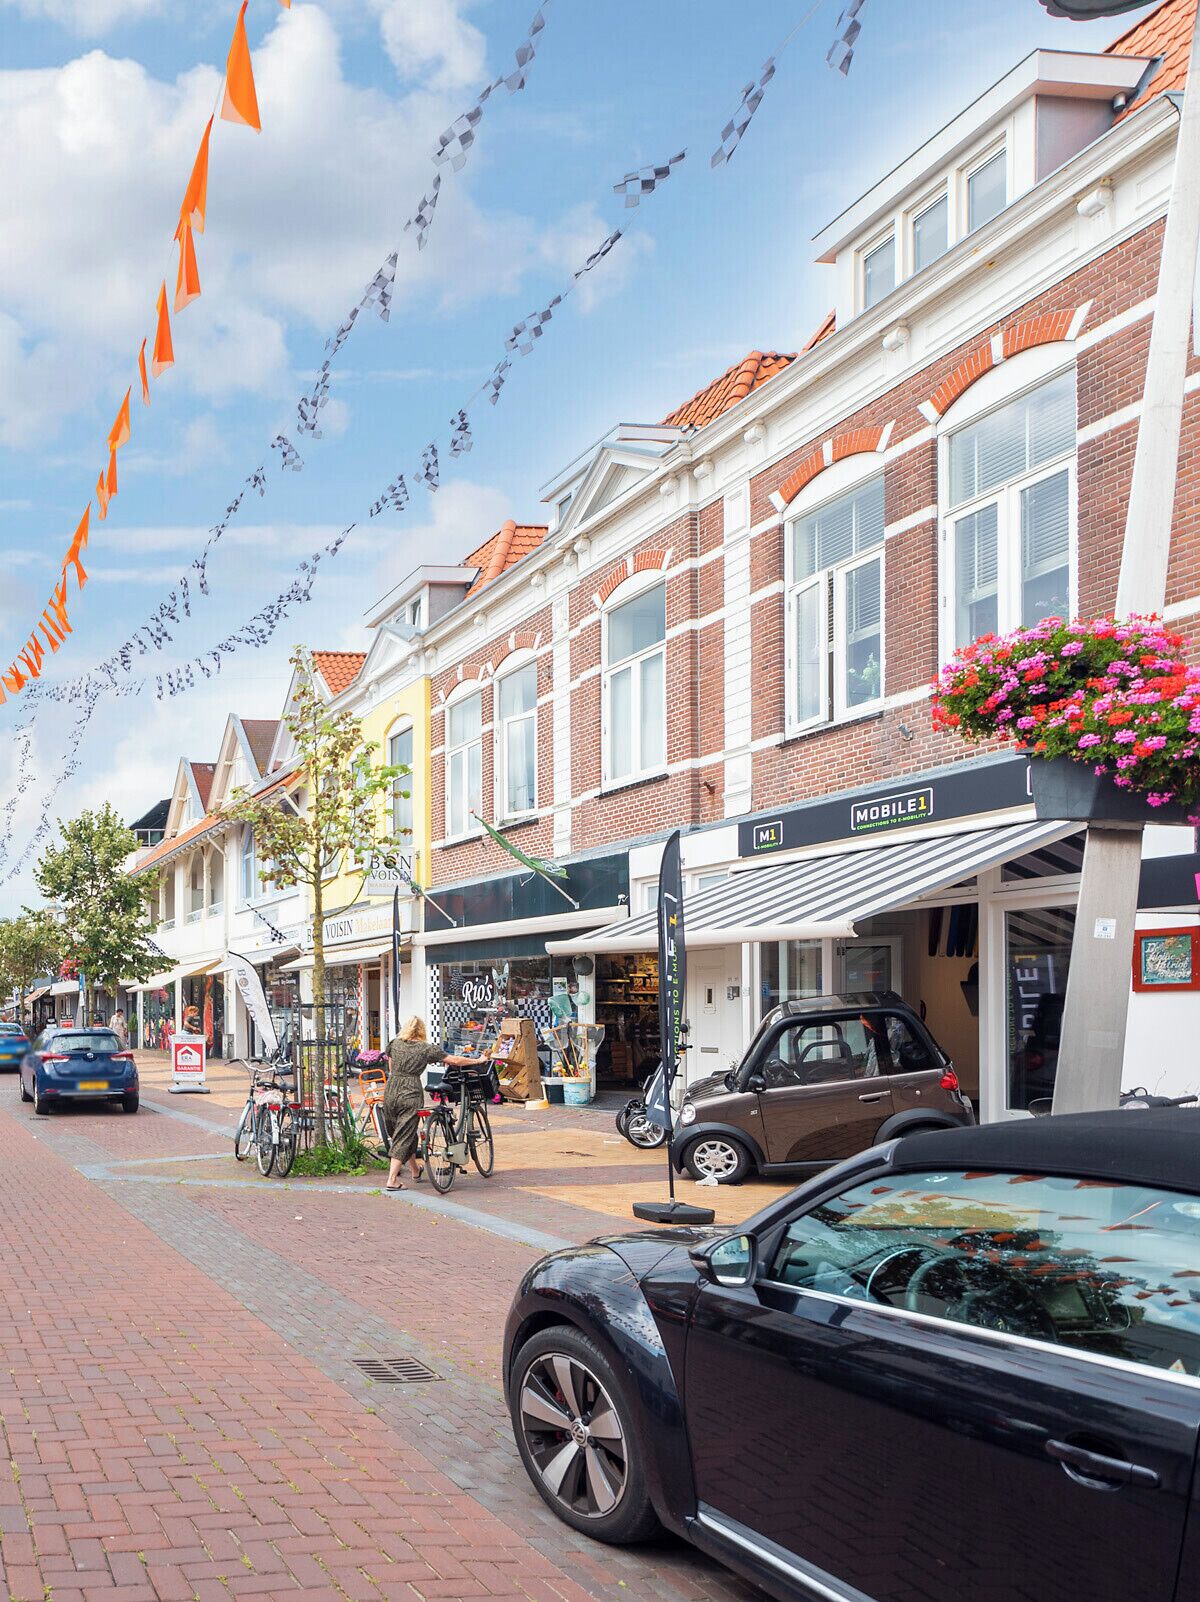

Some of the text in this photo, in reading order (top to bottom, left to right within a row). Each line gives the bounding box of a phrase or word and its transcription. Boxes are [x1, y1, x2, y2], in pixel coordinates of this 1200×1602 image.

[856, 796, 927, 823] MOBILE1
[856, 819, 889, 831] CONNECTIONS
[898, 813, 927, 822] E-MOBILITY
[760, 828, 777, 843] M1
[325, 919, 353, 940] VOISIN
[462, 975, 493, 1009] Rio's
